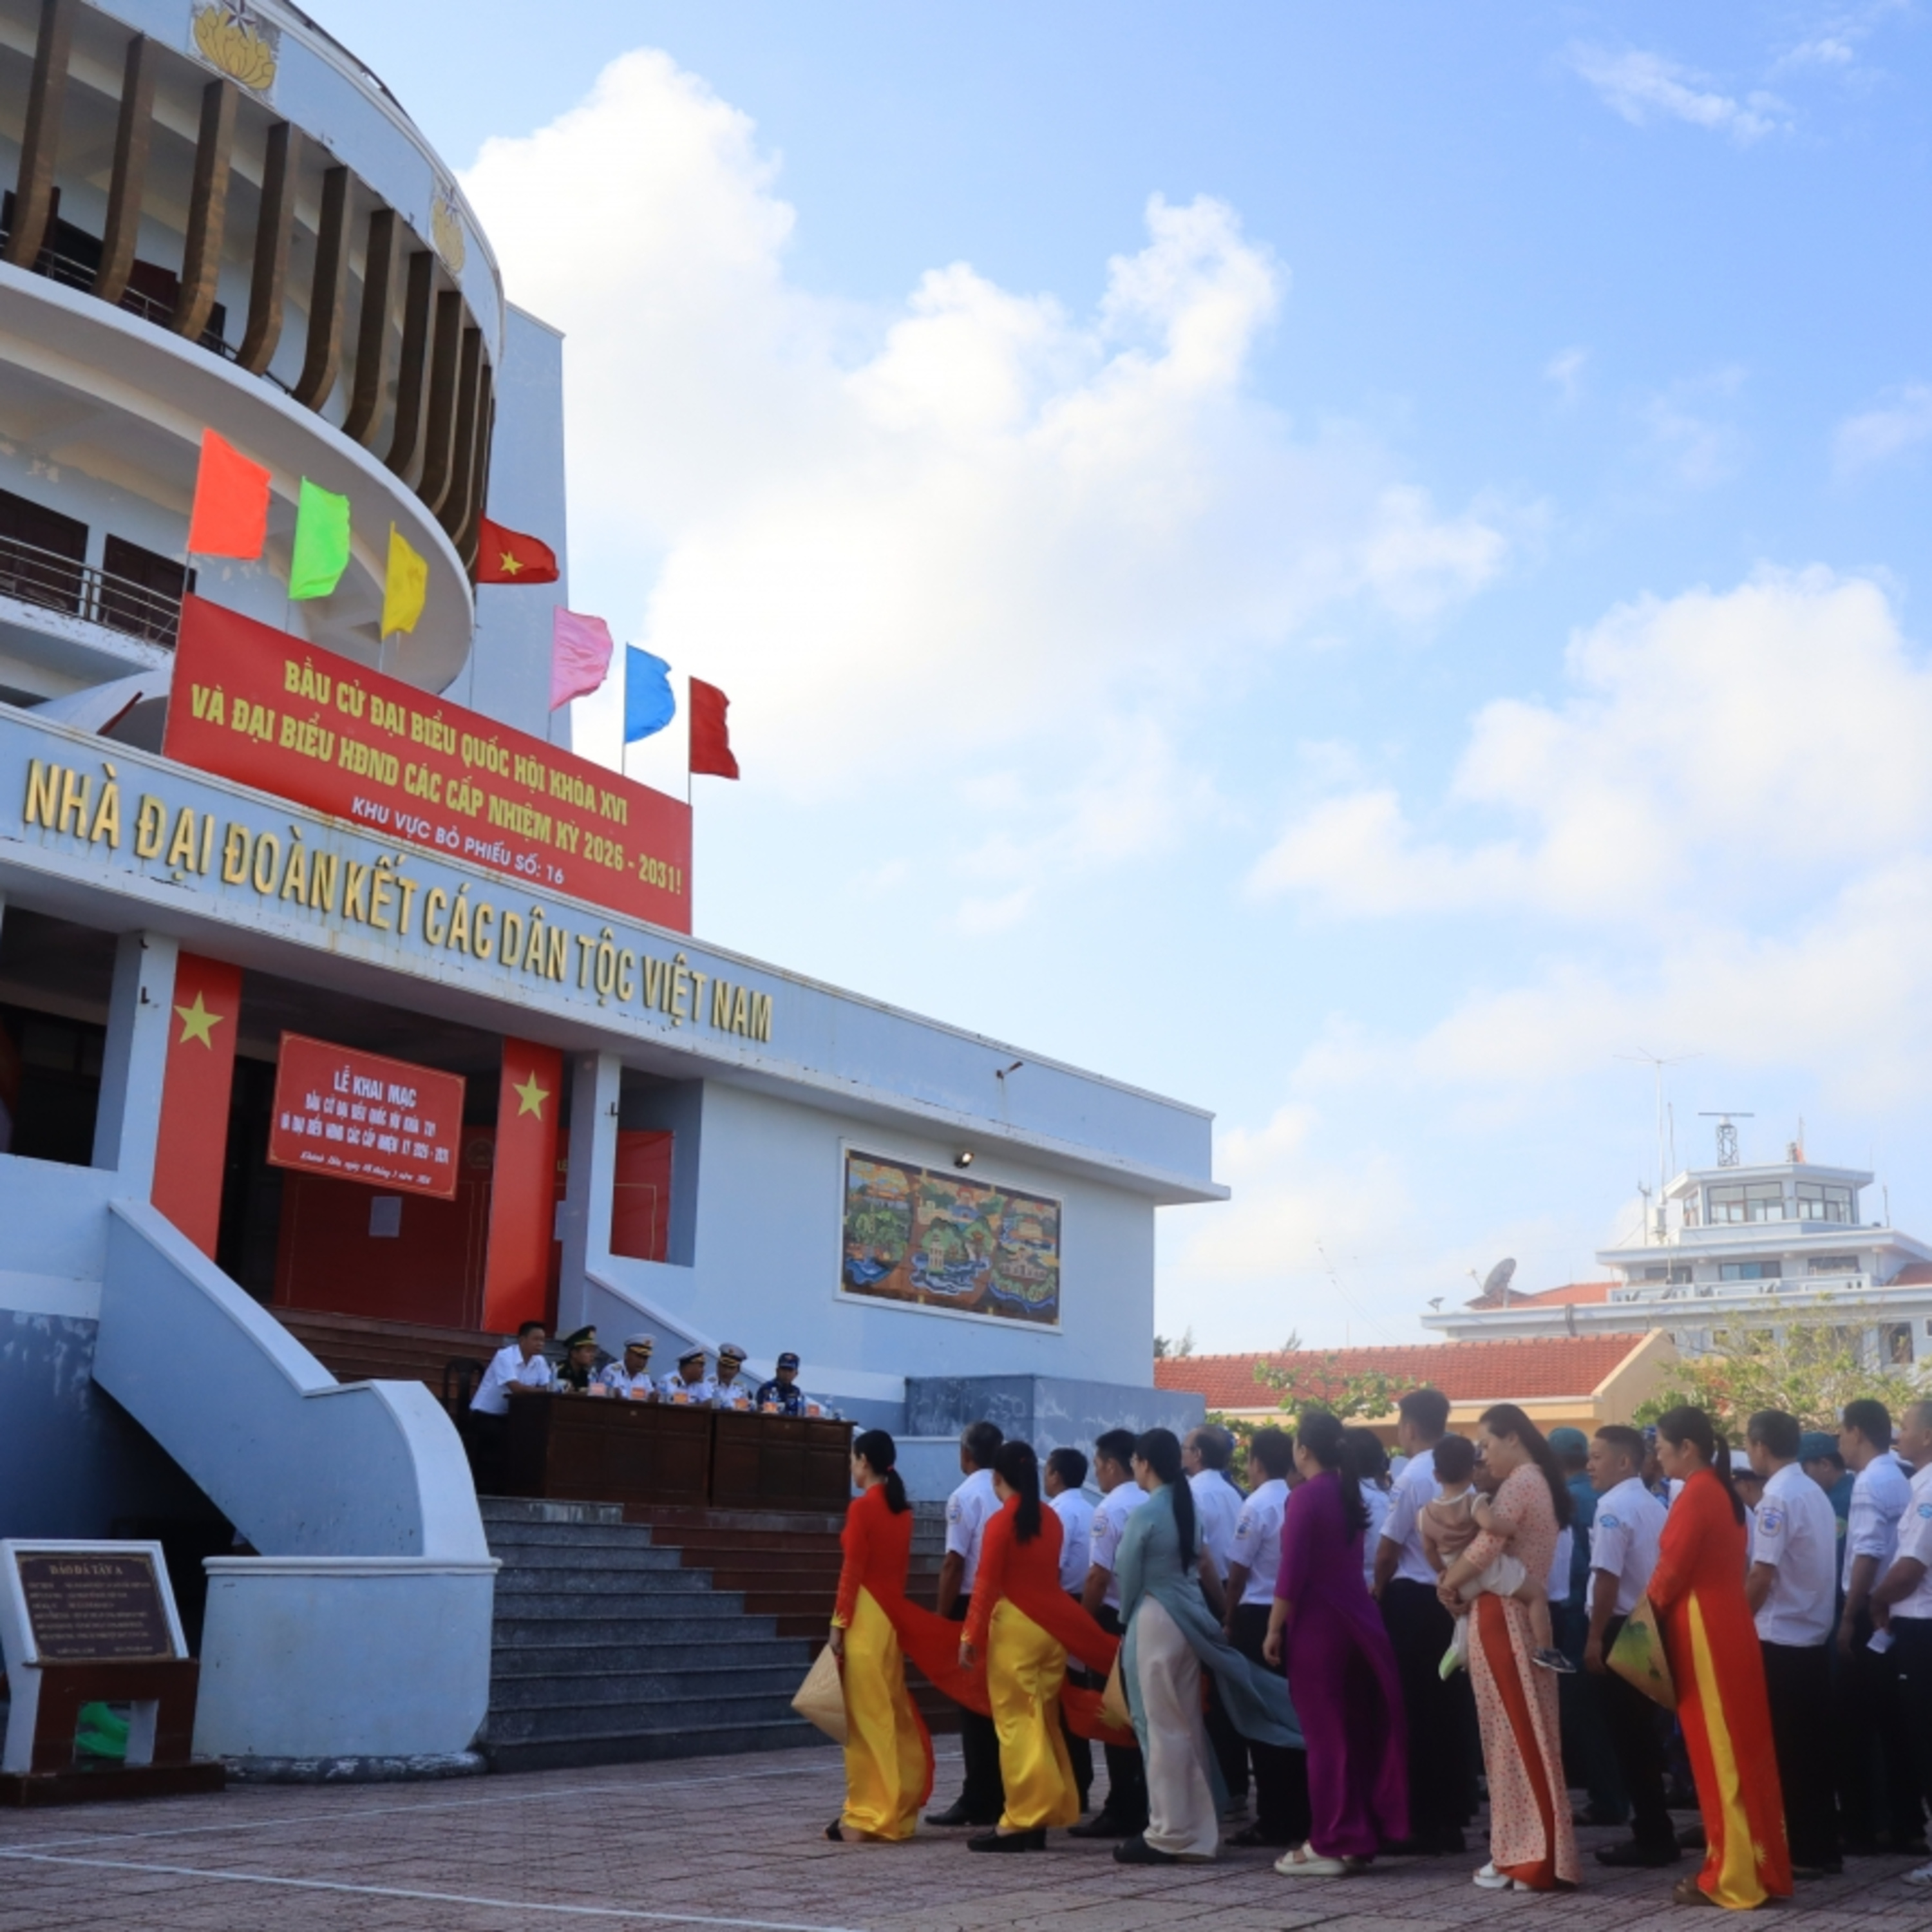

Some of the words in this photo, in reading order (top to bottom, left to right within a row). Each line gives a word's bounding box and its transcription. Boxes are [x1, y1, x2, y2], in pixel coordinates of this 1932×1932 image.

[191, 683, 225, 725] VÀ
[231, 697, 275, 743] ĐẠI
[279, 712, 335, 762] BIỂU
[338, 737, 399, 787] HĐND
[403, 762, 442, 804] CÁC
[446, 776, 484, 817] CẤP
[488, 795, 551, 844] NHIỆM
[555, 819, 579, 854] KỲ
[583, 833, 623, 872] 2026
[638, 853, 682, 895] 2031!
[285, 656, 331, 705] BẦU
[337, 679, 366, 718] CỬ
[370, 697, 405, 737] ĐẠI
[411, 710, 456, 755] BIỂU
[461, 734, 509, 777] QUỐC
[515, 754, 545, 793] HỘI
[549, 770, 596, 813] KHÓA
[600, 790, 627, 826] XVI
[23, 758, 120, 849] NHÀ
[135, 792, 215, 881] ĐẠI
[222, 825, 338, 913] ĐOÀN
[342, 853, 418, 935] KẾT
[423, 882, 495, 960] CÁC
[500, 905, 569, 982] DÂN
[575, 925, 635, 1006] TỘC
[642, 951, 707, 1027] VIỆT
[711, 978, 773, 1043] NAM
[351, 797, 389, 824] KHU
[395, 811, 431, 838] VỰC
[435, 825, 460, 849] BỎ
[464, 837, 511, 866] PHIẾU
[515, 853, 541, 876] SỐ:
[546, 864, 564, 884] 16
[334, 1065, 350, 1093] LỄ
[354, 1075, 383, 1101] KHAI
[388, 1084, 417, 1111] MẠC
